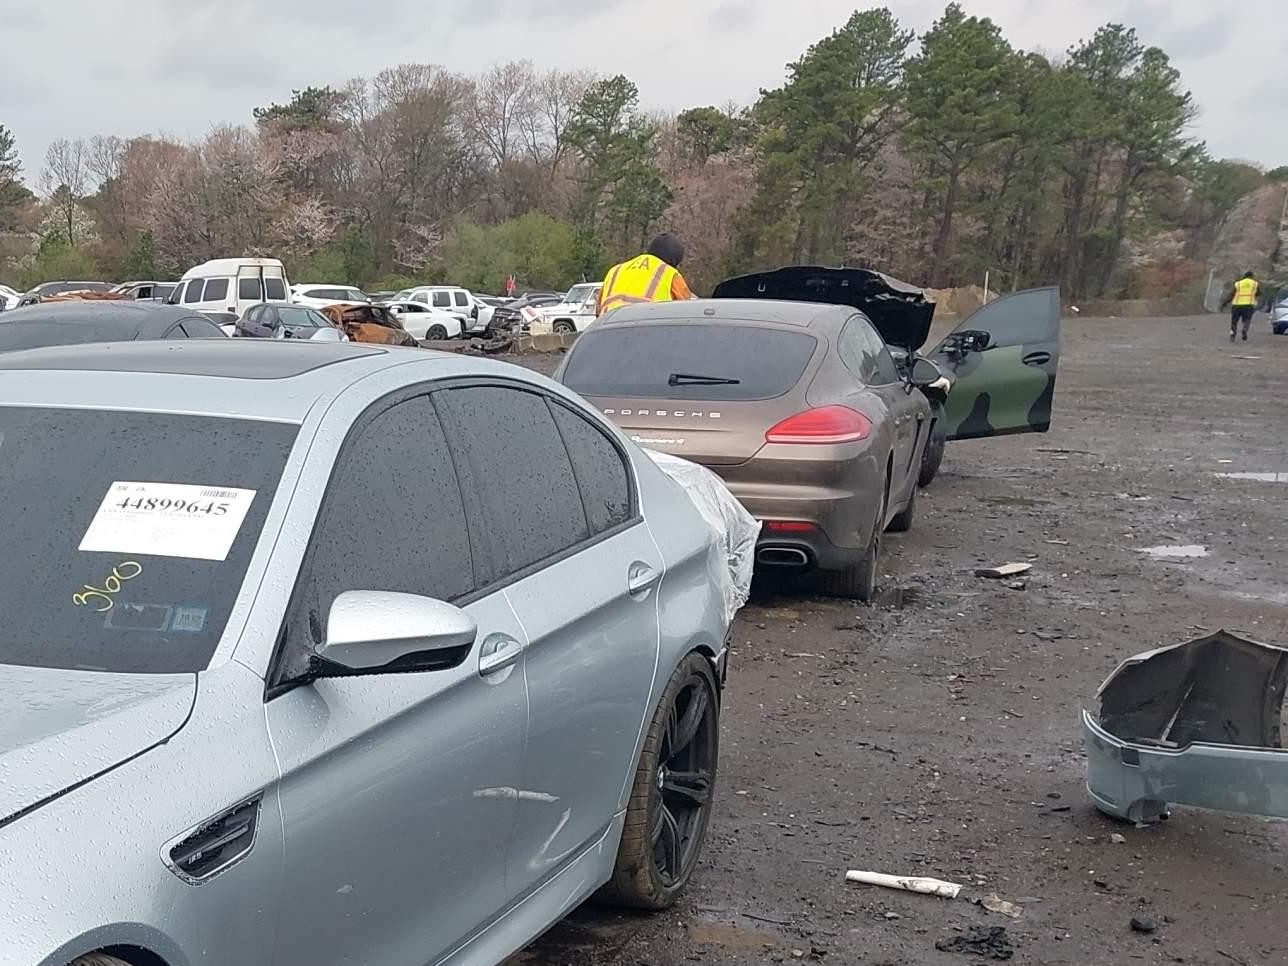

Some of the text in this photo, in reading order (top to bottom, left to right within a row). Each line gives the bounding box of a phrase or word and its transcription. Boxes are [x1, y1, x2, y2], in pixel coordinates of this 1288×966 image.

[603, 408, 721, 418] PORSCHE
[115, 496, 231, 516] 44899645
[72, 561, 142, 612] 360
